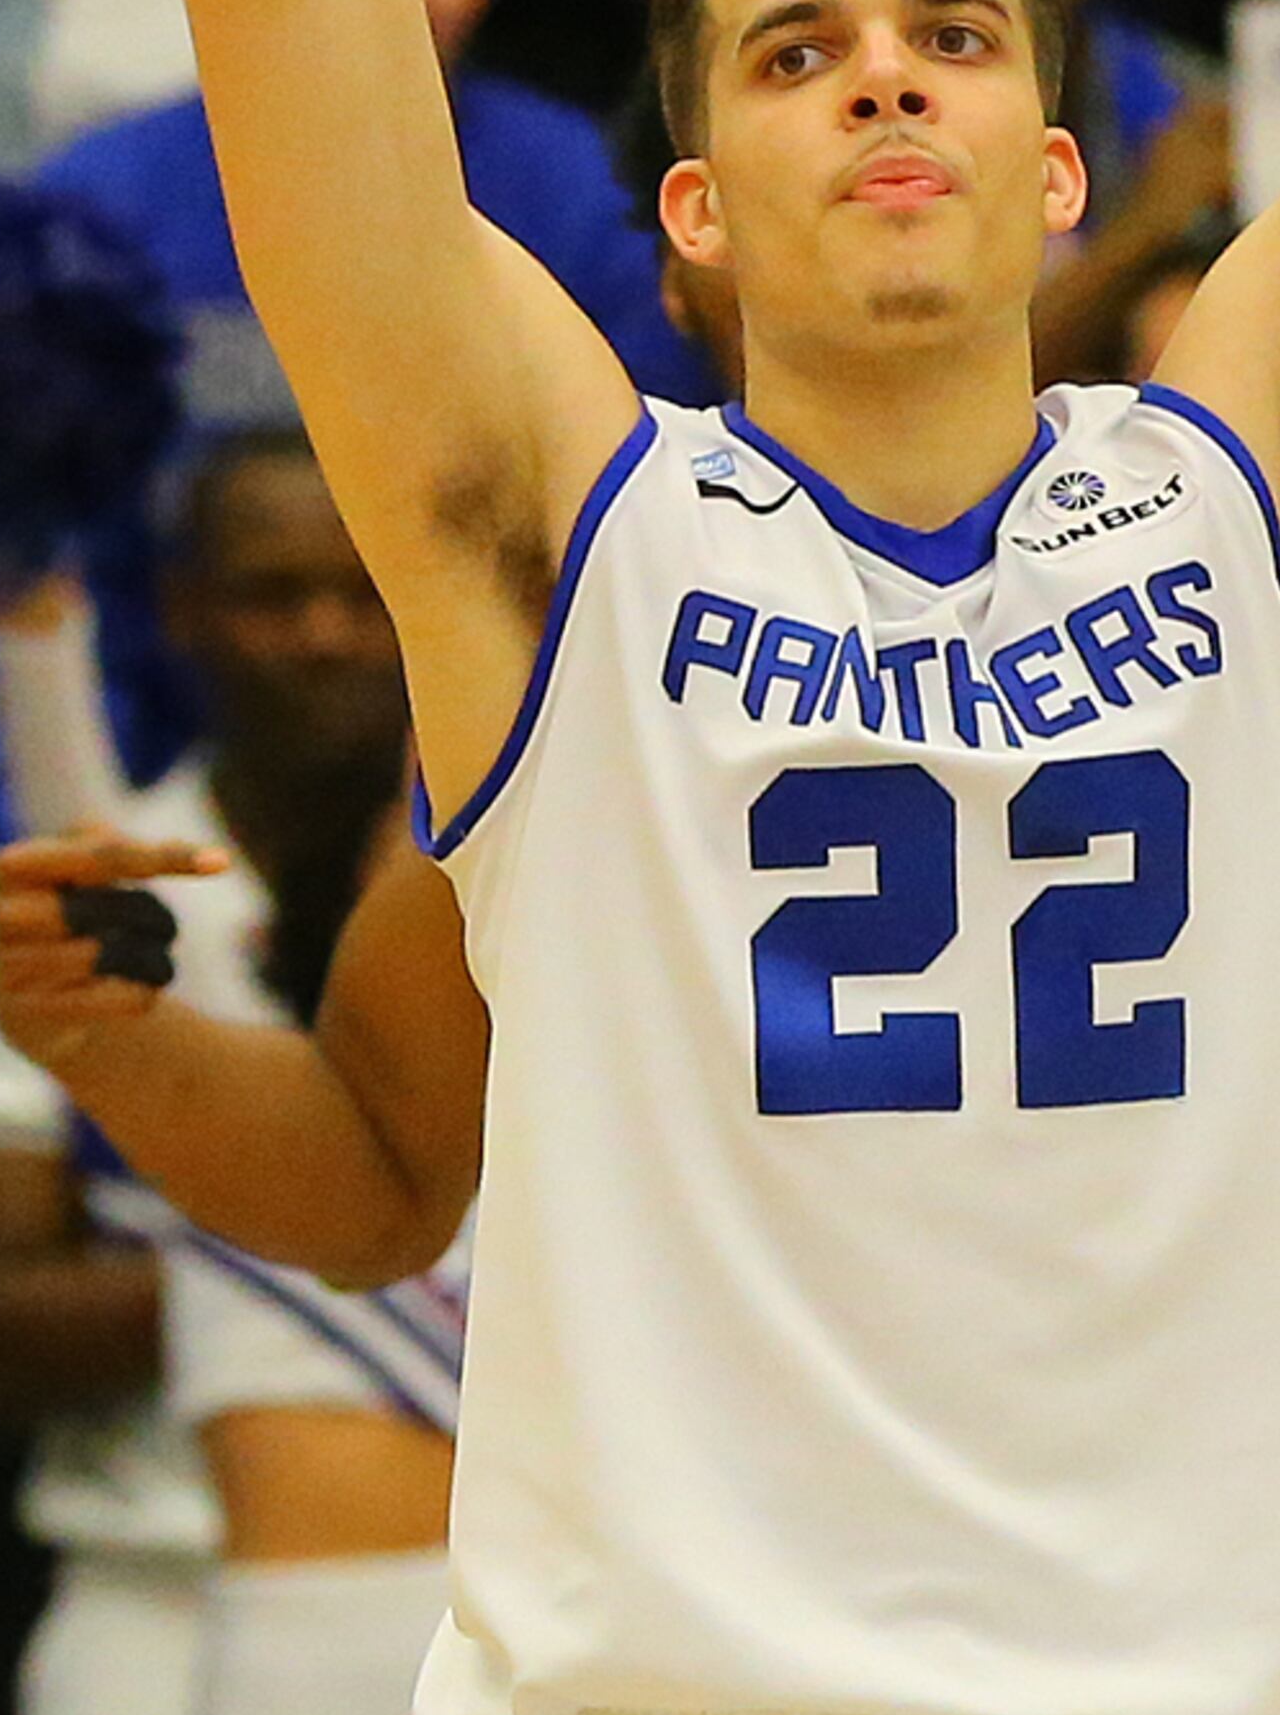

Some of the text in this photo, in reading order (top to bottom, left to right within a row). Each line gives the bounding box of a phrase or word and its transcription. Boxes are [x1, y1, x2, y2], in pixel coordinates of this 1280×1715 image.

[1010, 472, 1185, 553] SUN BELT
[660, 559, 1224, 749] PANTHERS
[747, 749, 1191, 1116] 22
